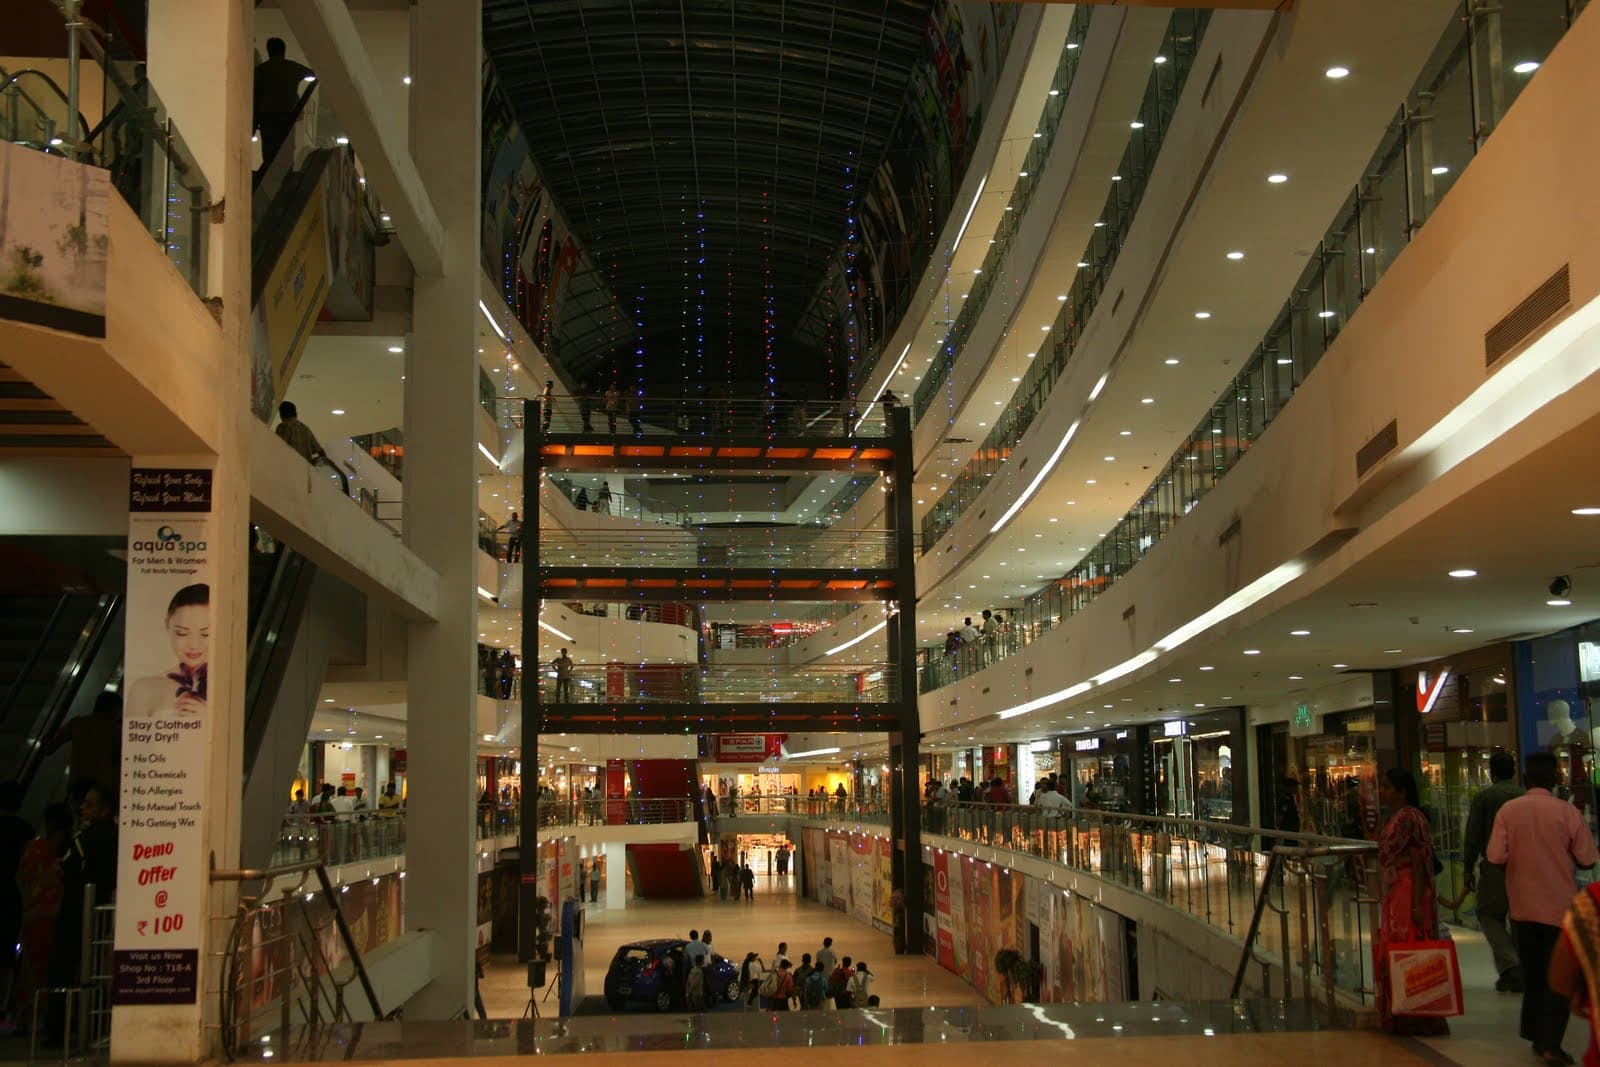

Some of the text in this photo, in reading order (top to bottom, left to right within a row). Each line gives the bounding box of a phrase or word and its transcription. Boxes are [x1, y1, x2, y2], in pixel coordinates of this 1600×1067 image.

[133, 541, 206, 554] aqua spa
[132, 557, 145, 565] For
[147, 557, 165, 565] Men
[175, 557, 206, 565] Women
[128, 720, 201, 731] Stay Clothed!
[128, 733, 152, 744] Stay
[133, 753, 166, 763] No Oils
[133, 769, 187, 779] No Chemicals
[132, 786, 183, 796] No Allergies
[131, 802, 201, 811] No Manual Touch
[131, 818, 195, 829] No Getting Wet
[133, 842, 174, 861] Demo
[138, 865, 178, 886] Offer
[155, 890, 168, 908] @
[154, 914, 184, 935] 100
[130, 952, 148, 960] Visit
[164, 952, 183, 960] Now
[120, 964, 142, 974] Shop
[144, 964, 157, 972] No
[136, 976, 175, 984] 3rd Floor
